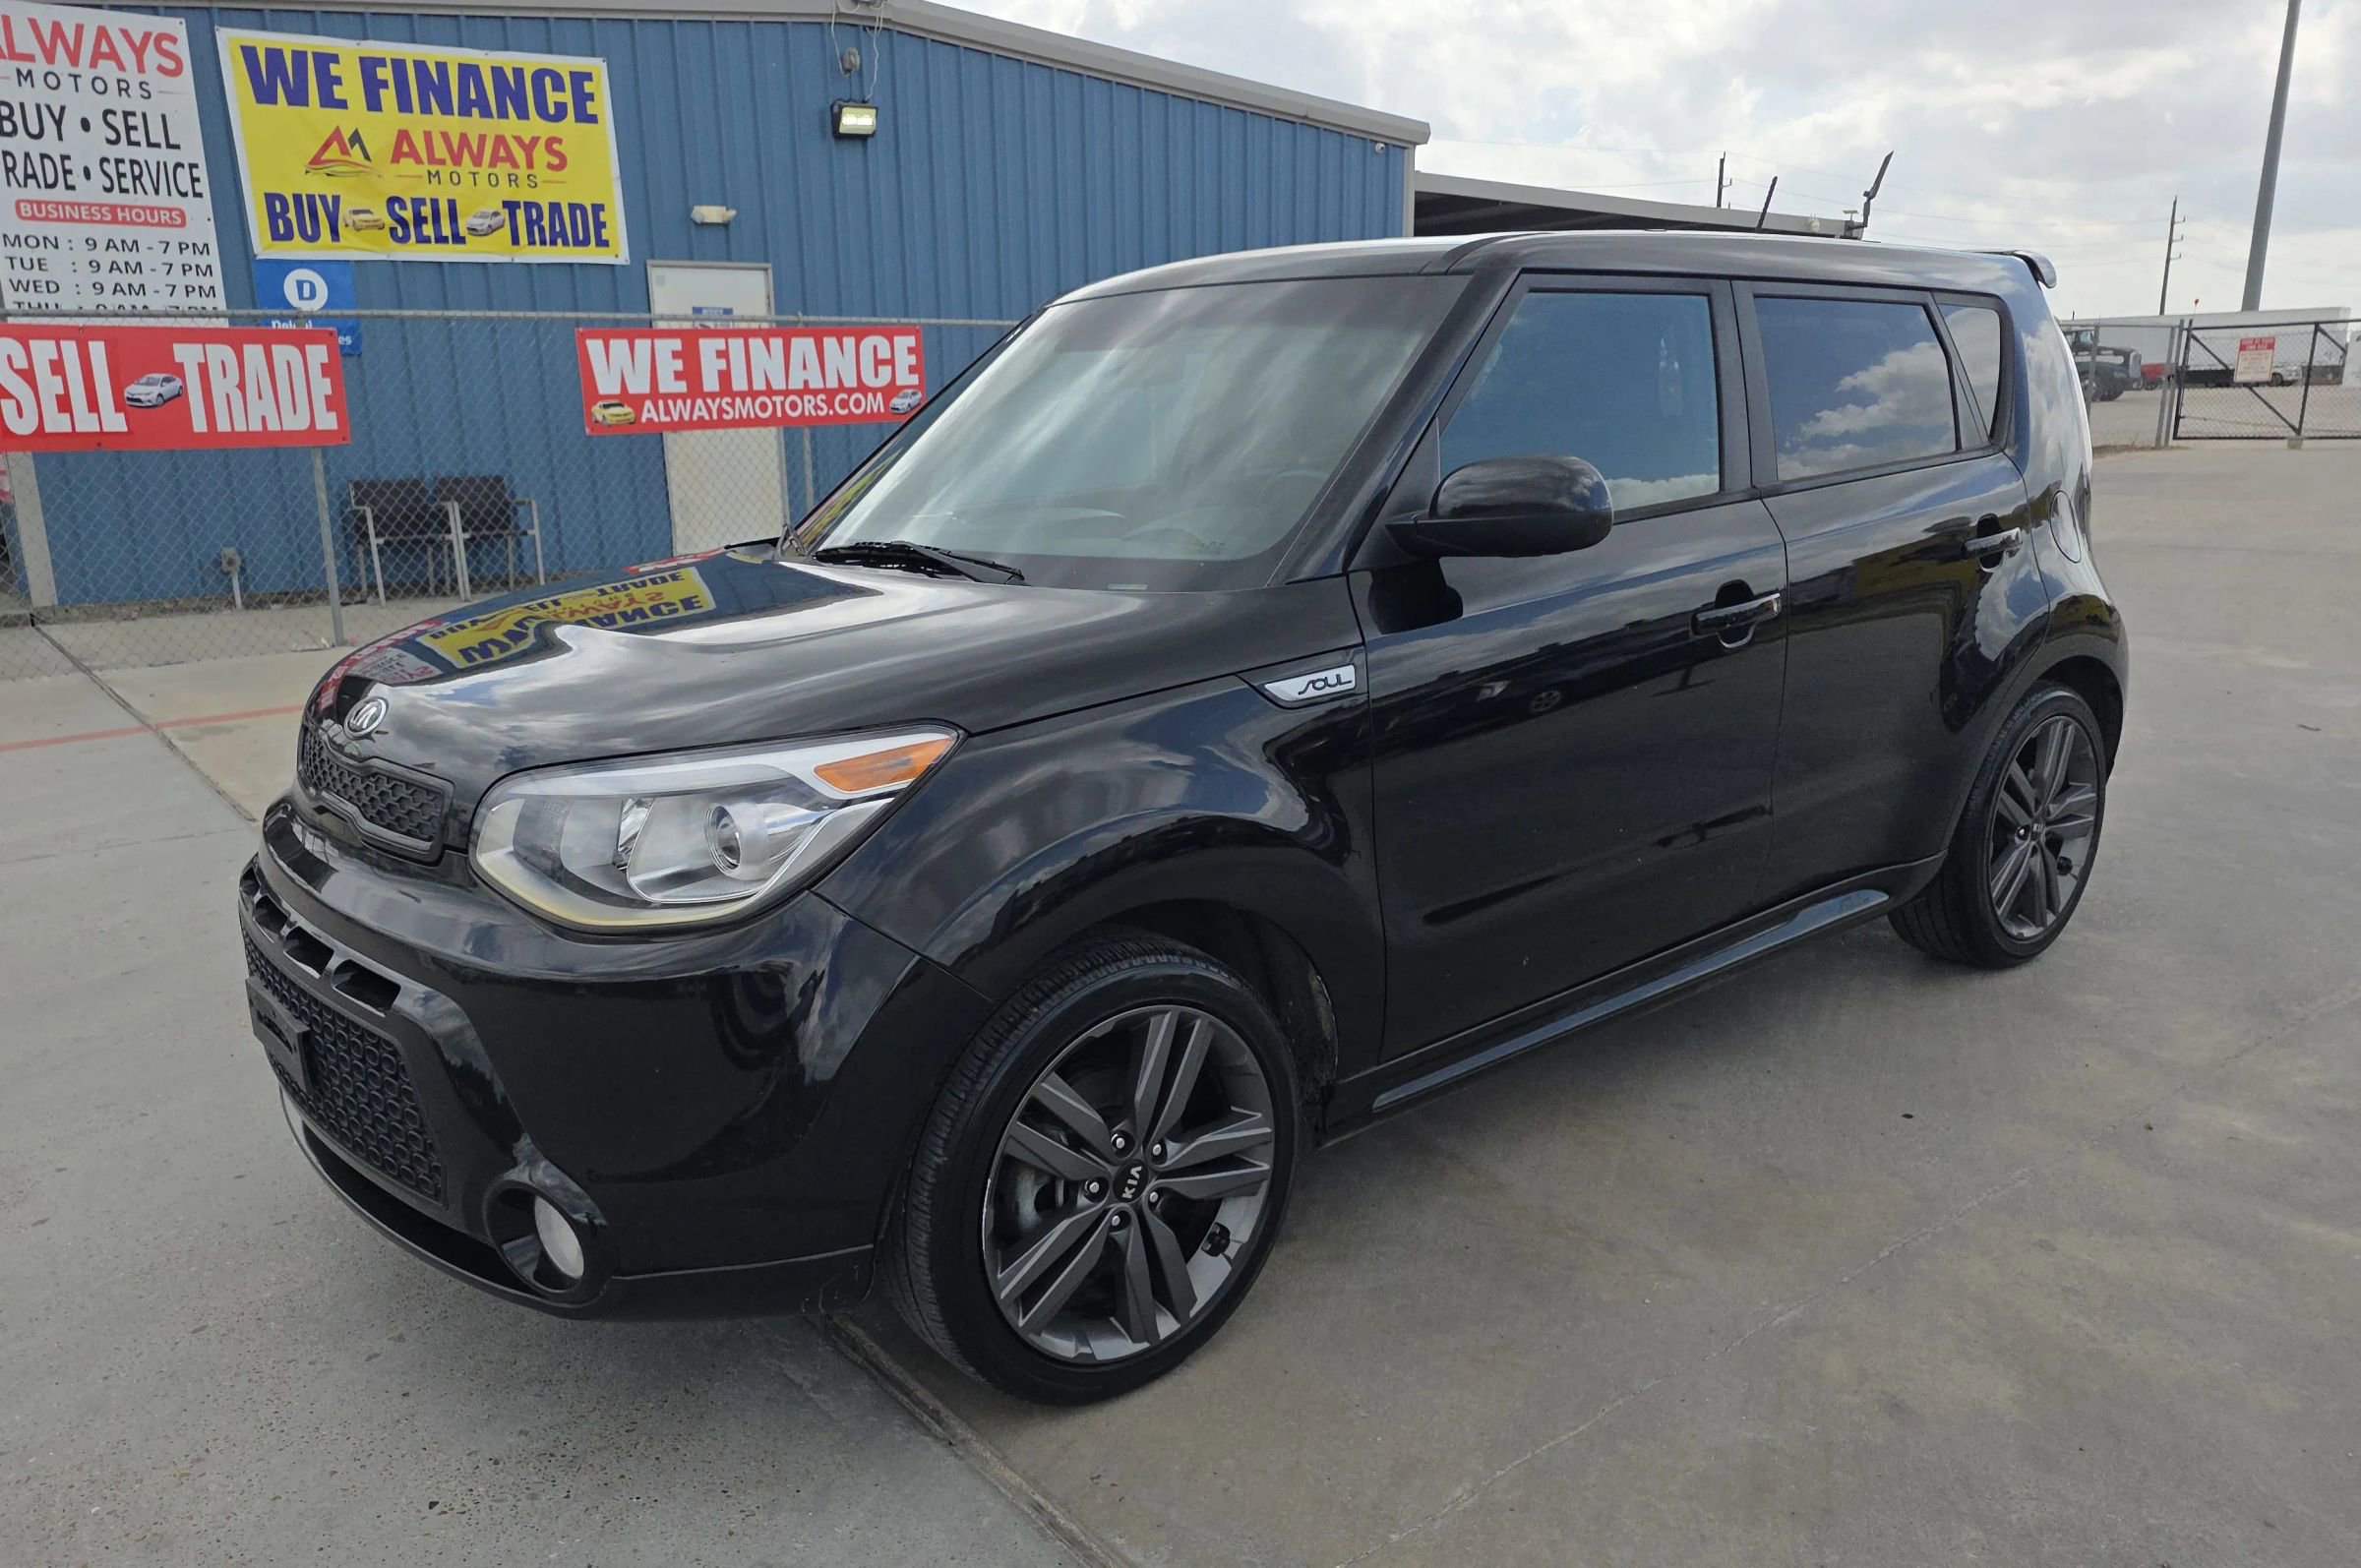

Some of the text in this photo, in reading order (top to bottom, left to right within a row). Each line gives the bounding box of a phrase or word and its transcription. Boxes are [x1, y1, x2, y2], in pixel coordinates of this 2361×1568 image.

[0, 14, 184, 79] LWAYS
[16, 67, 152, 99] MOTORS
[239, 44, 599, 125] WE FINANCE
[0, 100, 181, 150] BUY SELL
[390, 128, 569, 172] ALWAYS
[98, 156, 204, 198] SERVICE
[426, 169, 538, 189] MOTORS
[19, 202, 182, 225] BUSINESS HOURS
[263, 192, 610, 248] BUY SELL TRADE
[2, 233, 59, 250] MON
[85, 237, 97, 252] 9
[104, 238, 140, 253] AM
[158, 240, 170, 254] 7
[178, 242, 211, 256] PM
[5, 256, 49, 271] TUE
[89, 260, 101, 273] 9
[108, 260, 144, 274] AM
[161, 263, 174, 276] 7
[181, 264, 213, 277] PM
[9, 278, 60, 294] WED
[92, 282, 104, 296] 9
[112, 282, 147, 296] AM
[165, 284, 177, 297] 7
[185, 285, 216, 299] PM
[295, 279, 317, 301] D
[585, 334, 920, 395] WE FINANCE
[0, 337, 339, 437] SELL TRADE
[640, 392, 885, 424] ALWAYSMOTORS.COM
[1298, 674, 1353, 695] SOUL
[1121, 1166, 1143, 1199] KIA
